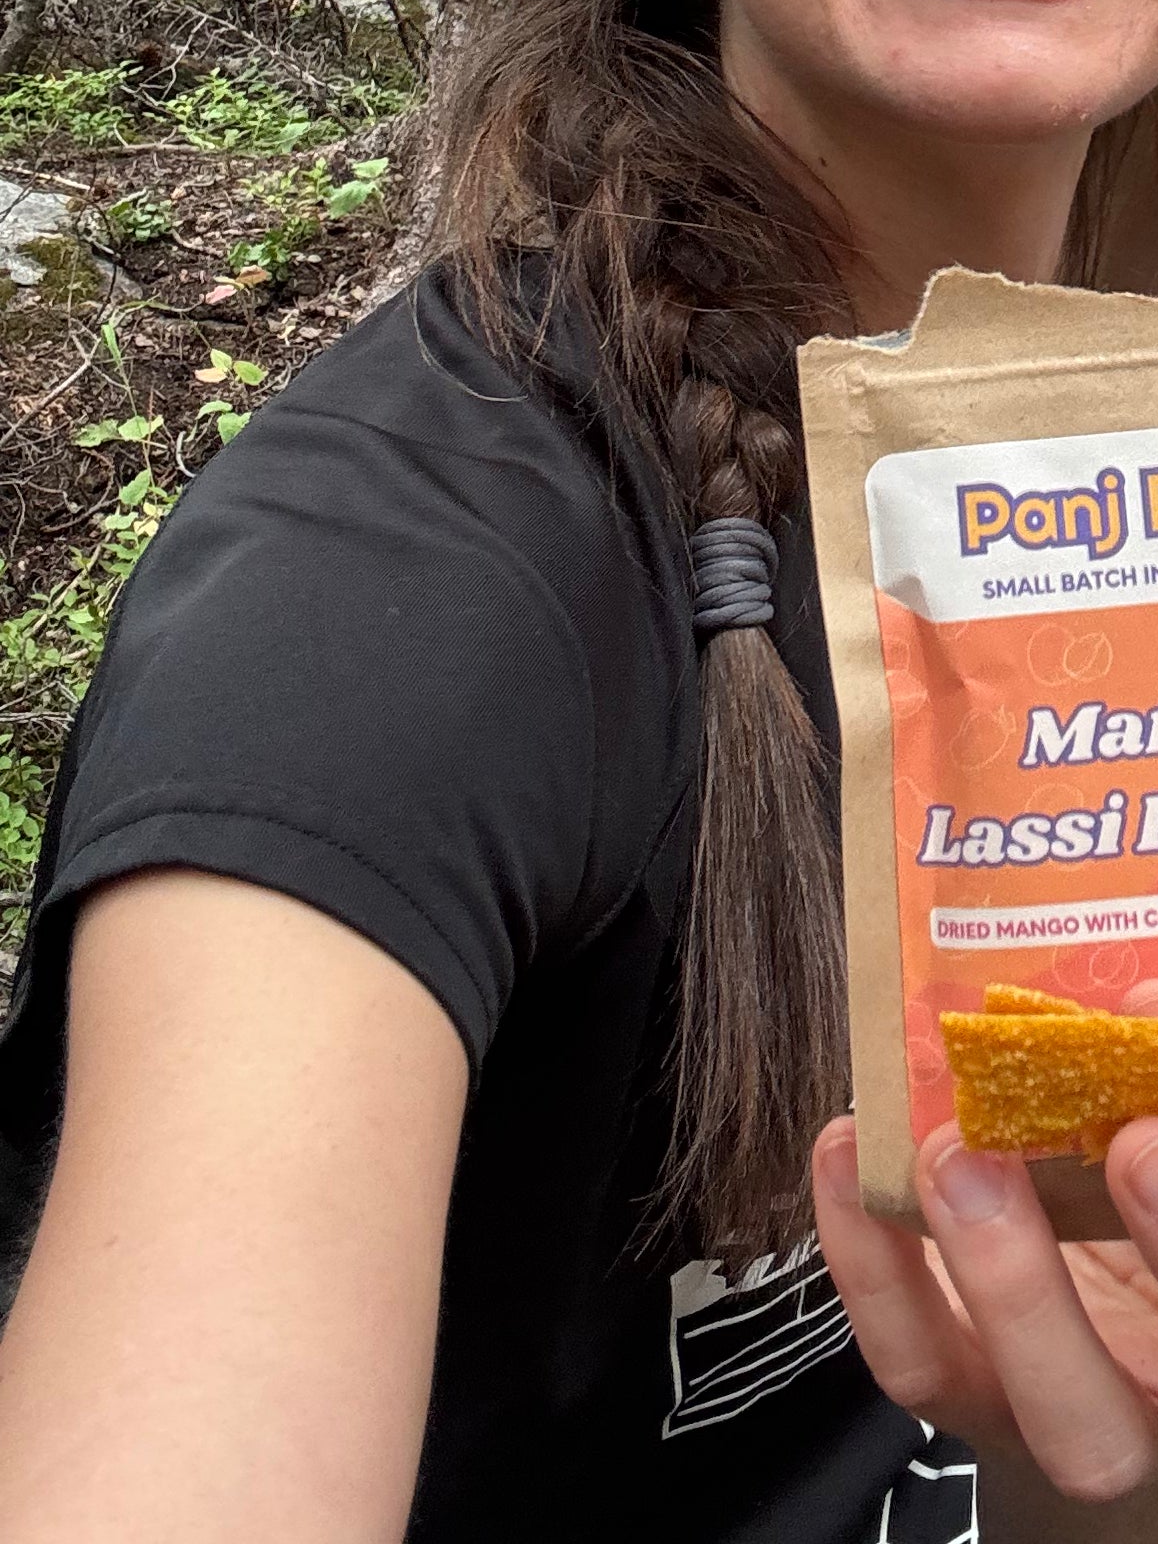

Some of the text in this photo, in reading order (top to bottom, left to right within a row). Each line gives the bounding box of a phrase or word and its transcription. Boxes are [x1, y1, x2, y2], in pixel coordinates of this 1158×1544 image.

[957, 467, 1127, 561] Panj
[983, 577, 1056, 599] SMALL
[1061, 566, 1137, 592] BATCH
[916, 790, 1125, 867] Lassi
[938, 919, 990, 939] DRIED
[997, 916, 1079, 939] MANGO
[1084, 910, 1138, 932] WITH
